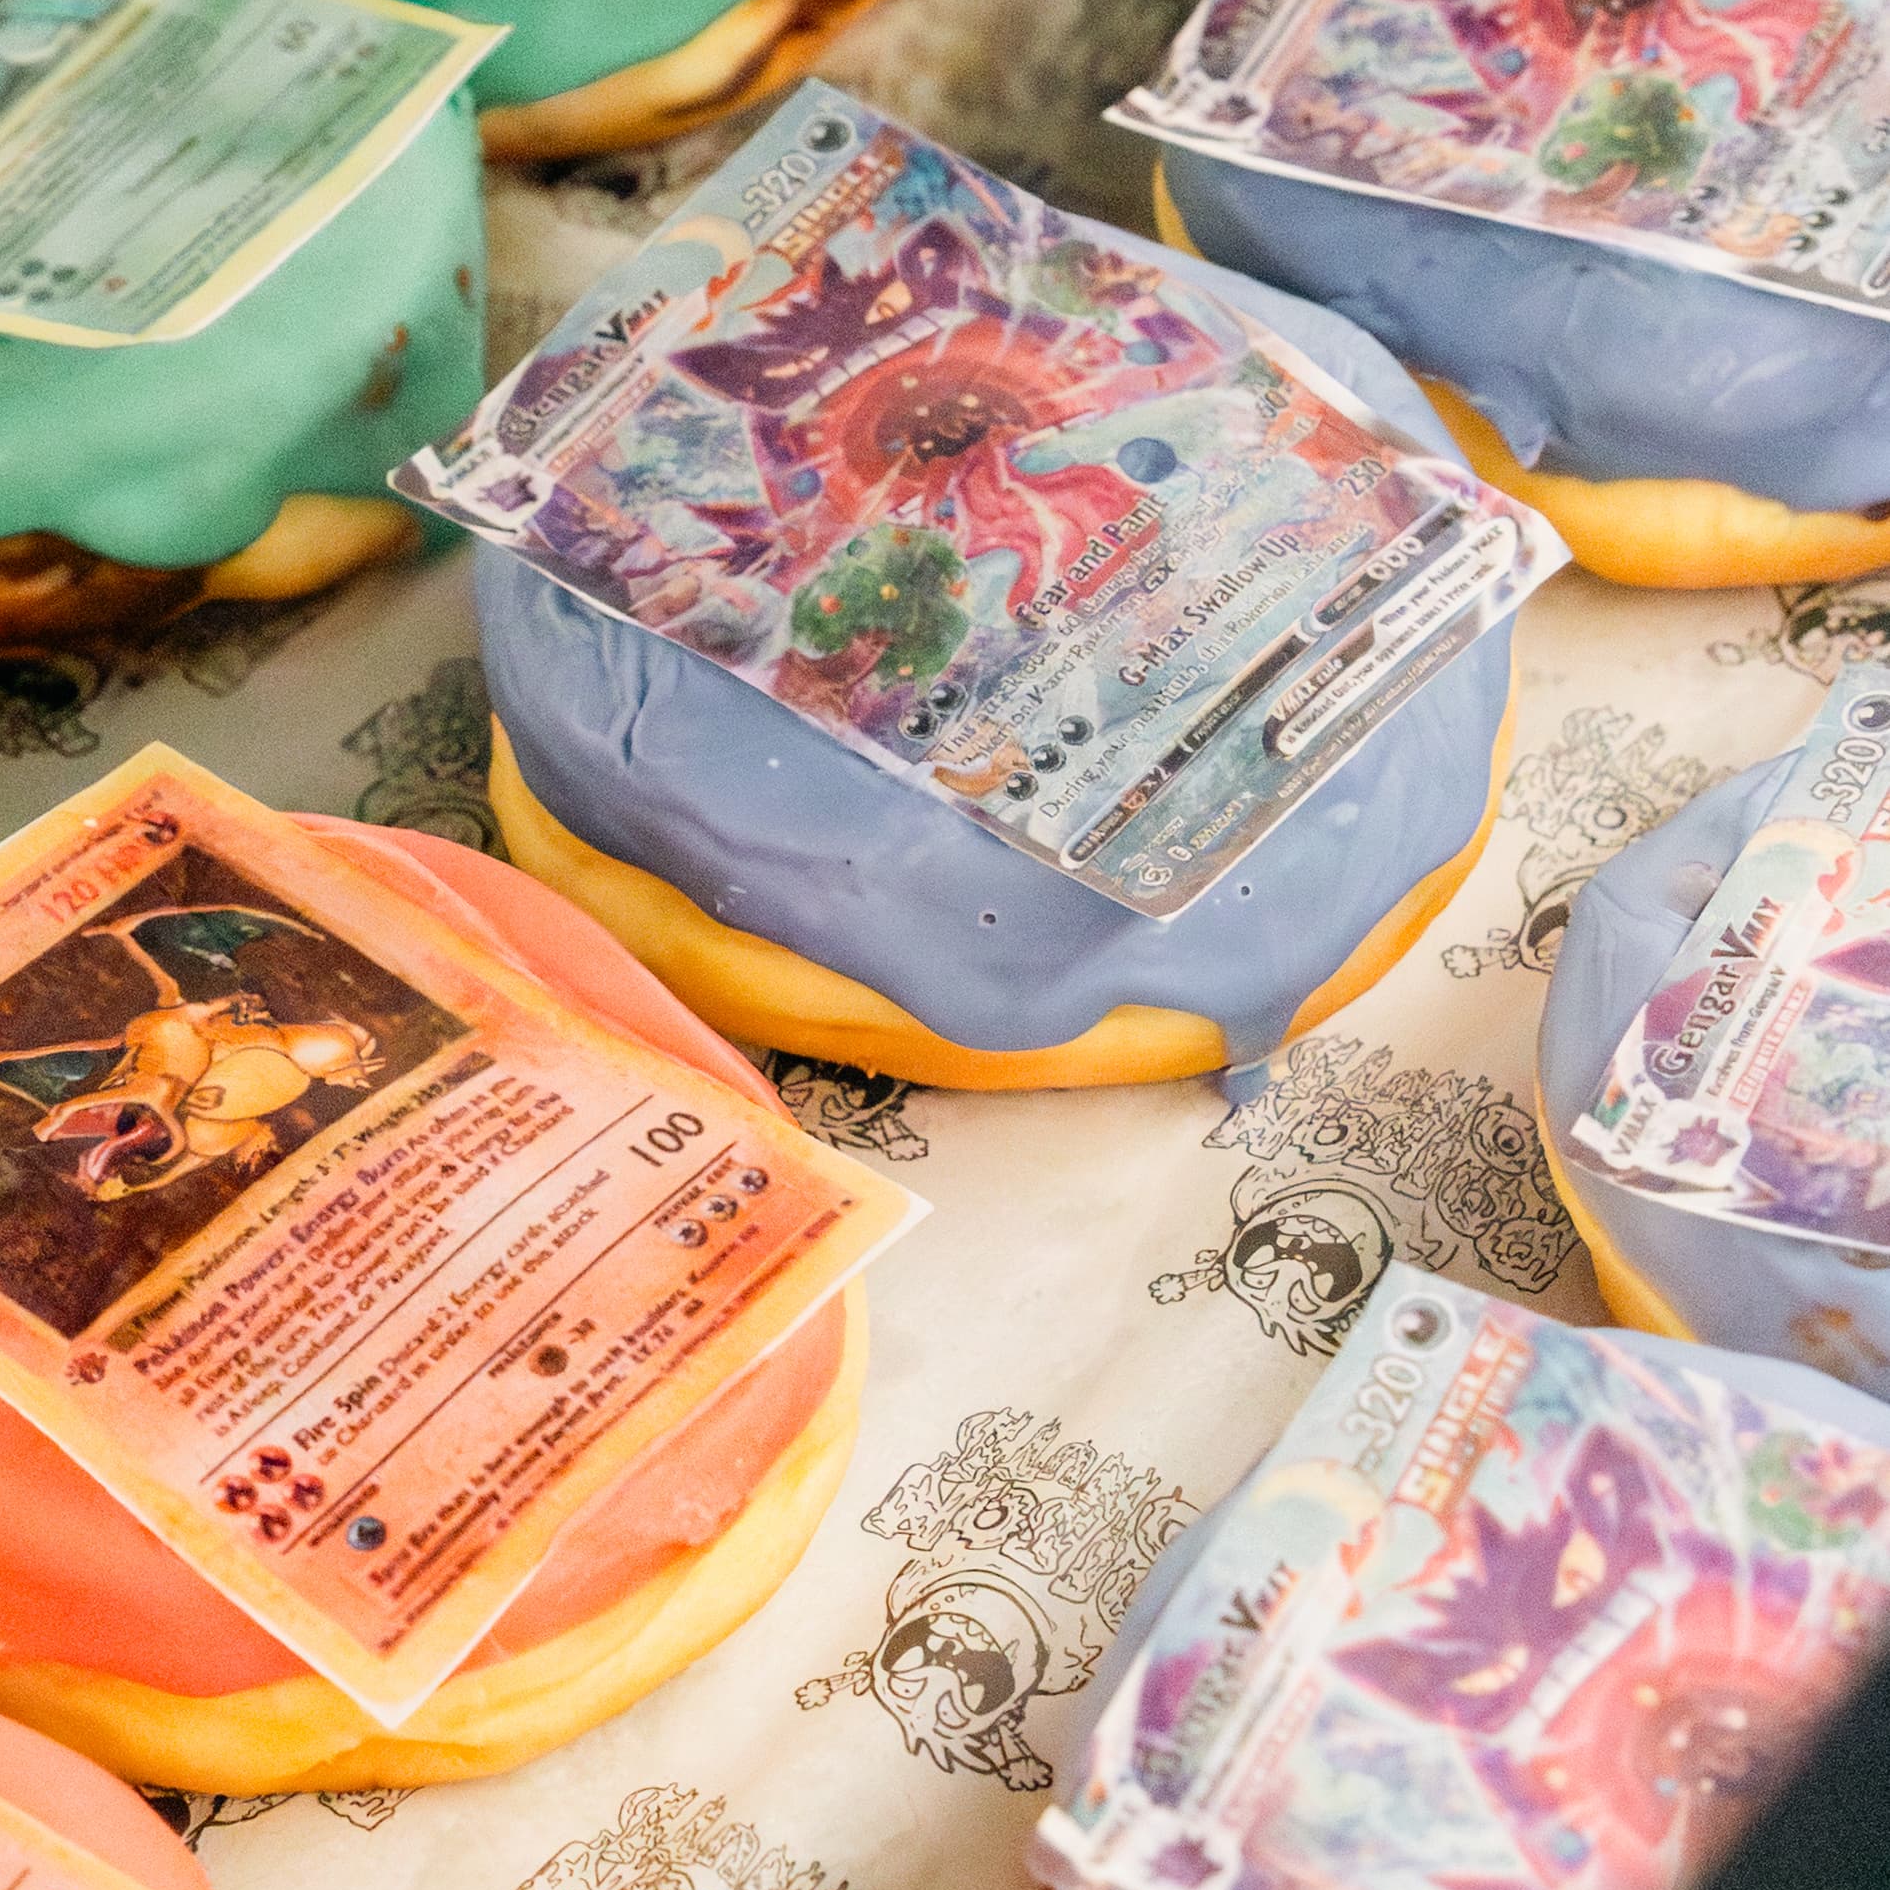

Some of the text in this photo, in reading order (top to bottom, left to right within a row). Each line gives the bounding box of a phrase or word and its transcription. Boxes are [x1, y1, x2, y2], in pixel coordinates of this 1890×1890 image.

[734, 144, 826, 218] 320
[1333, 452, 1394, 500] 250
[1010, 486, 1173, 628] Fear and Panic
[1051, 612, 1086, 638] 60
[1111, 524, 1311, 689] G-Max Swallow Up
[1806, 724, 1890, 817] 320
[34, 873, 106, 926] 120
[1648, 885, 1786, 1087] Gengar VMAX
[624, 1102, 713, 1172] 100
[1608, 1092, 1660, 1160] VMAX
[284, 1181, 367, 1248] Energy
[351, 1140, 412, 1189] Burn
[288, 1408, 342, 1454] Fire
[329, 1367, 392, 1420] Spin
[443, 1252, 516, 1312] Energy
[541, 1165, 614, 1227] attached
[1331, 1345, 1435, 1451] 320
